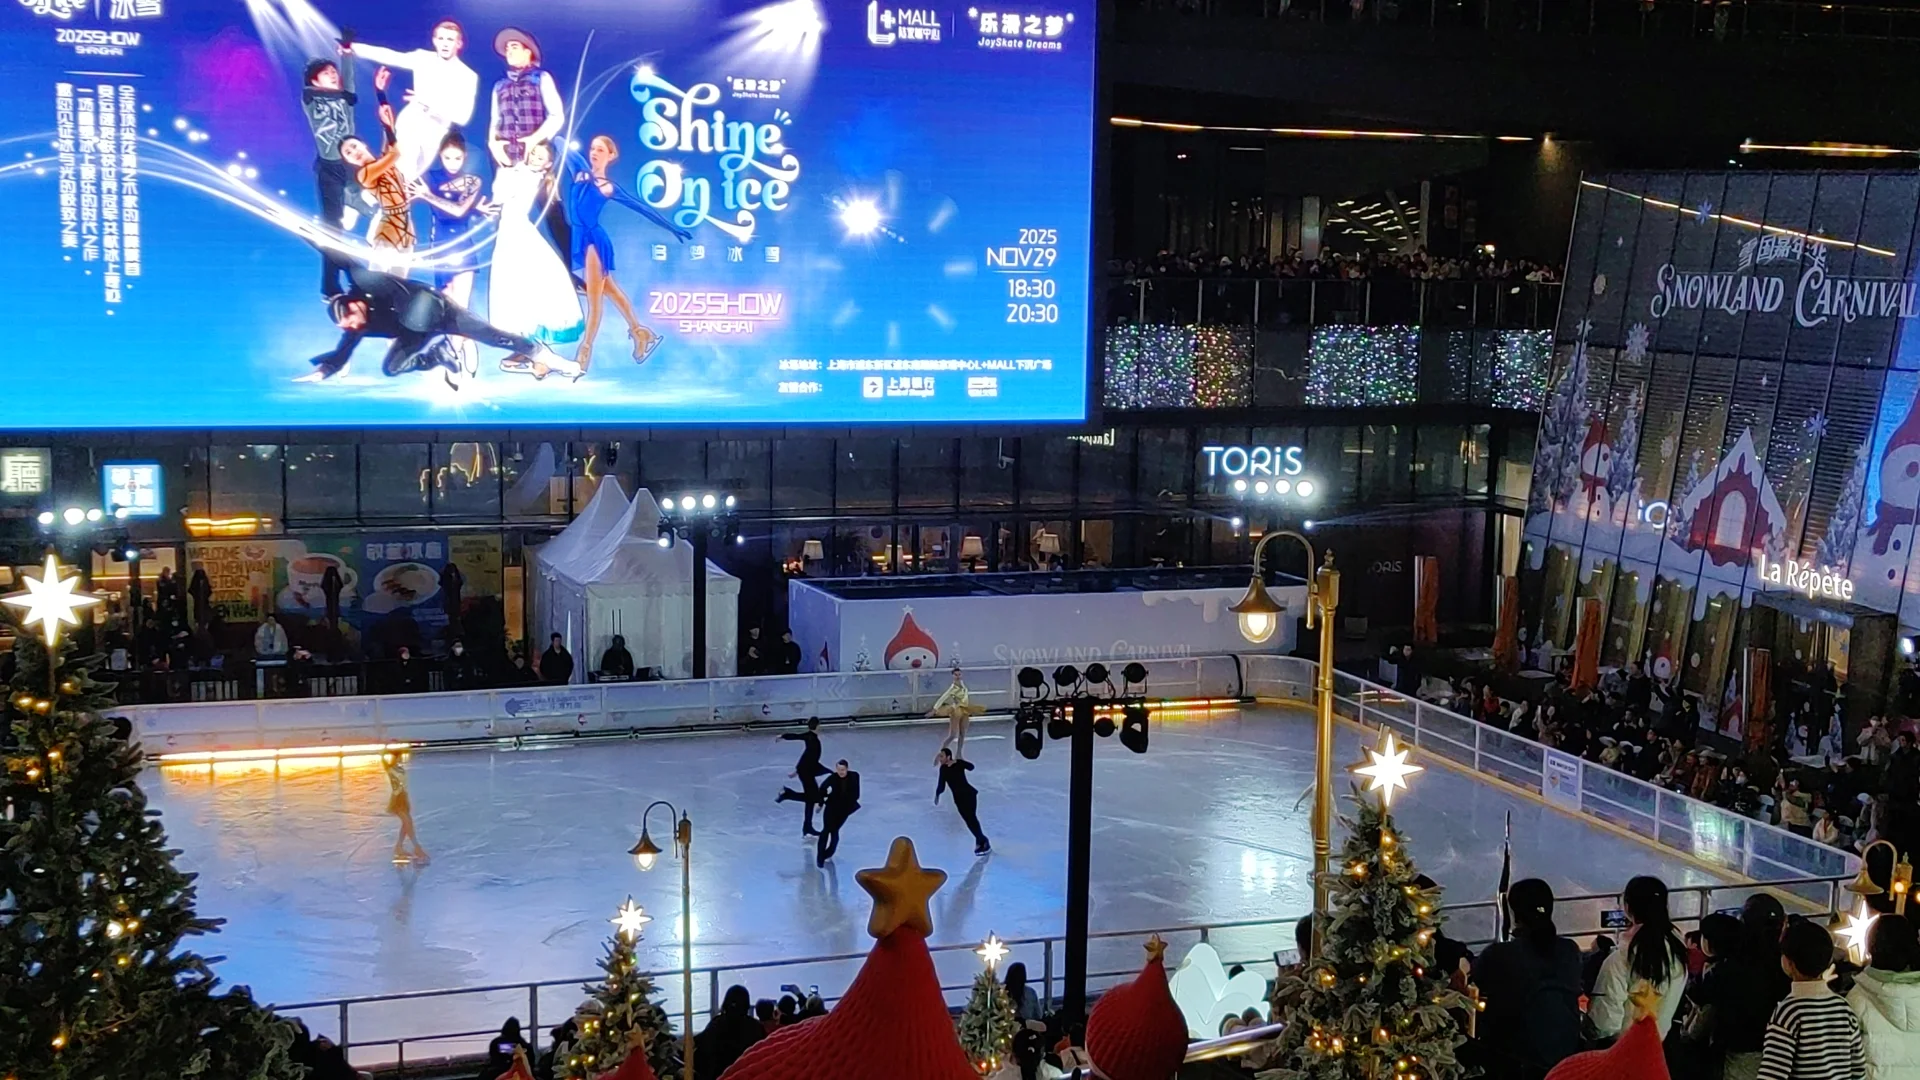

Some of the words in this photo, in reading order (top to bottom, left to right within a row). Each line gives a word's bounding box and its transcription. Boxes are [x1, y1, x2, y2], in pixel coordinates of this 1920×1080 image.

[980, 12, 1064, 35] 乐滑之梦
[978, 37, 1023, 48] JoySkate
[1026, 38, 1062, 50] Dreams
[630, 66, 800, 183] Shine
[1019, 228, 1057, 244] 2025
[1738, 234, 1829, 271] 雪国嘉年华
[1008, 279, 1056, 298] 18:30
[1650, 263, 1785, 318] SNOWLAND
[1795, 267, 1920, 327] CARNIVAL
[649, 291, 782, 316] 2025SHOW
[1006, 303, 1058, 323] 20:30
[679, 319, 754, 334] SHANGHAI
[1759, 554, 1781, 583] La
[1786, 560, 1853, 599] Répète
